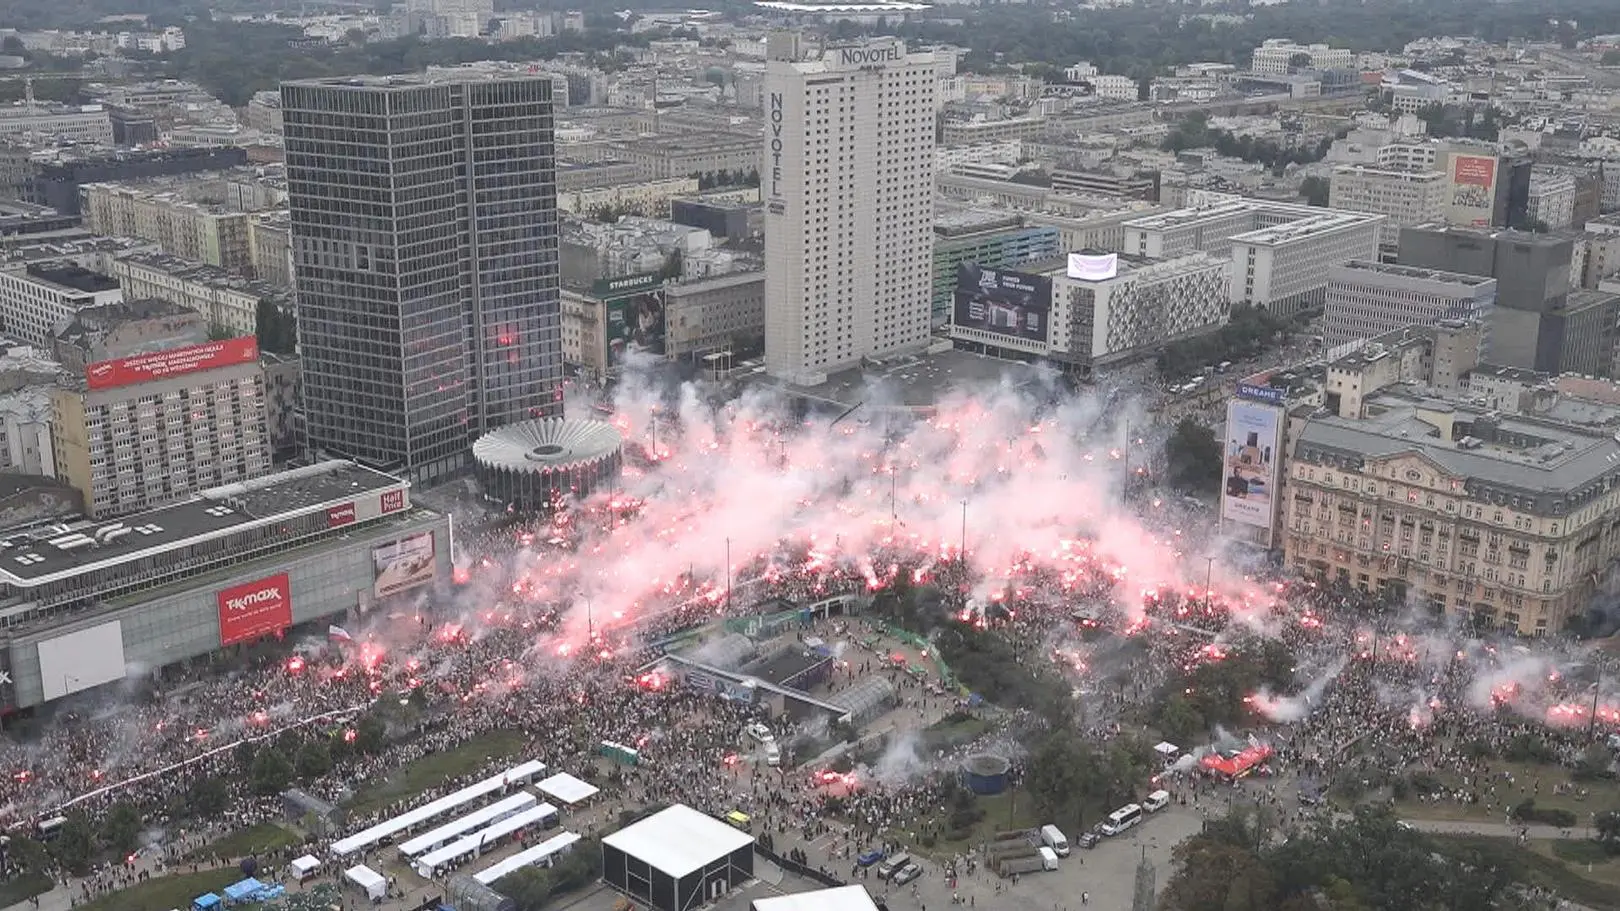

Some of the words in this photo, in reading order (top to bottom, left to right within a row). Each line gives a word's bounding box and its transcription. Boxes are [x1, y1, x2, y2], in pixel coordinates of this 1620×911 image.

[842, 46, 902, 65] NOVOTEL
[771, 92, 782, 196] NOVOTEL
[609, 275, 653, 290] STARBUCKS
[383, 491, 401, 503] Half
